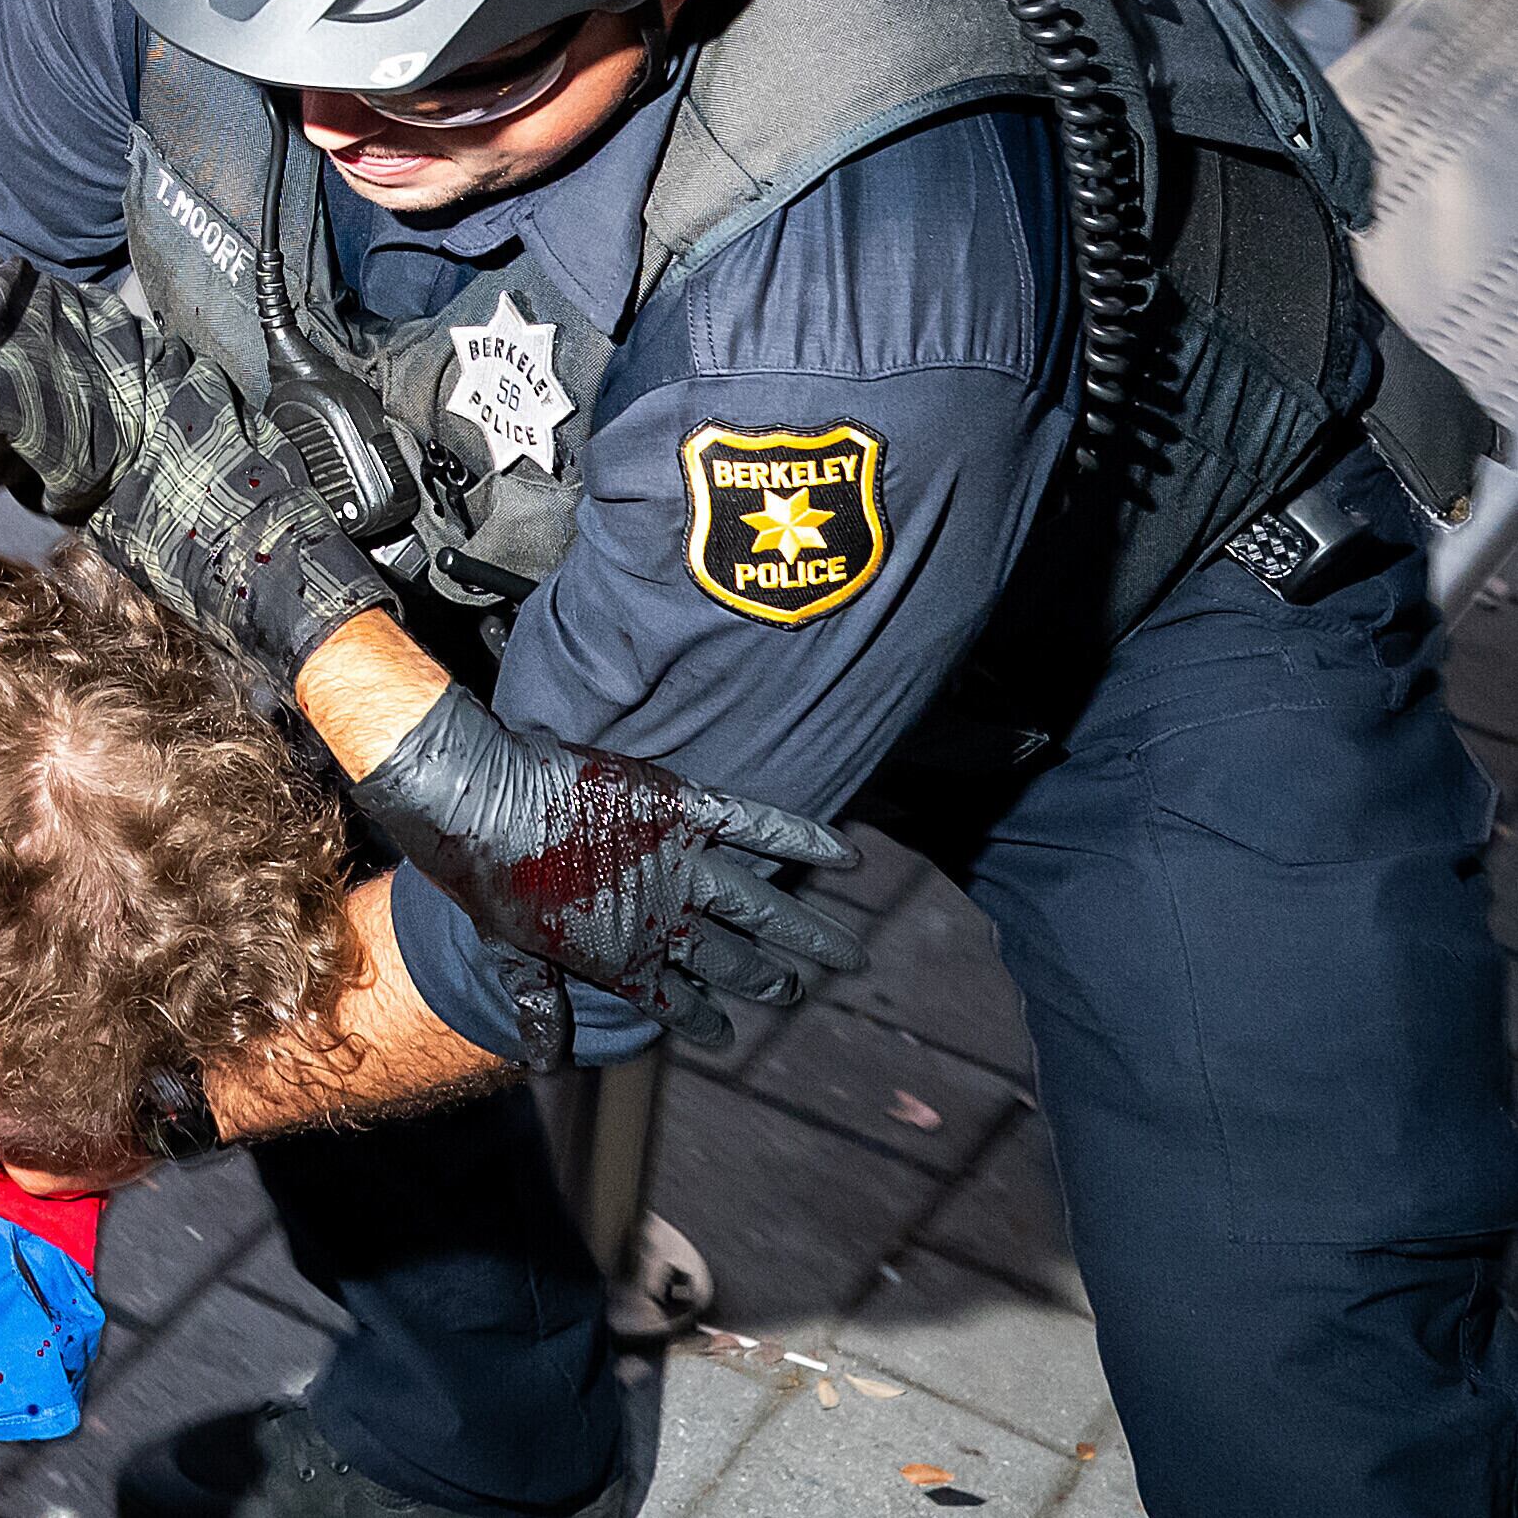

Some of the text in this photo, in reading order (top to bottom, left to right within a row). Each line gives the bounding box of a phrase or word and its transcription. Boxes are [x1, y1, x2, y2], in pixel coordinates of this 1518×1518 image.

[467, 336, 554, 407] BERKELEY
[468, 389, 538, 446] POLICE
[712, 454, 859, 490] BERKELEY
[734, 555, 848, 590] POLICE
